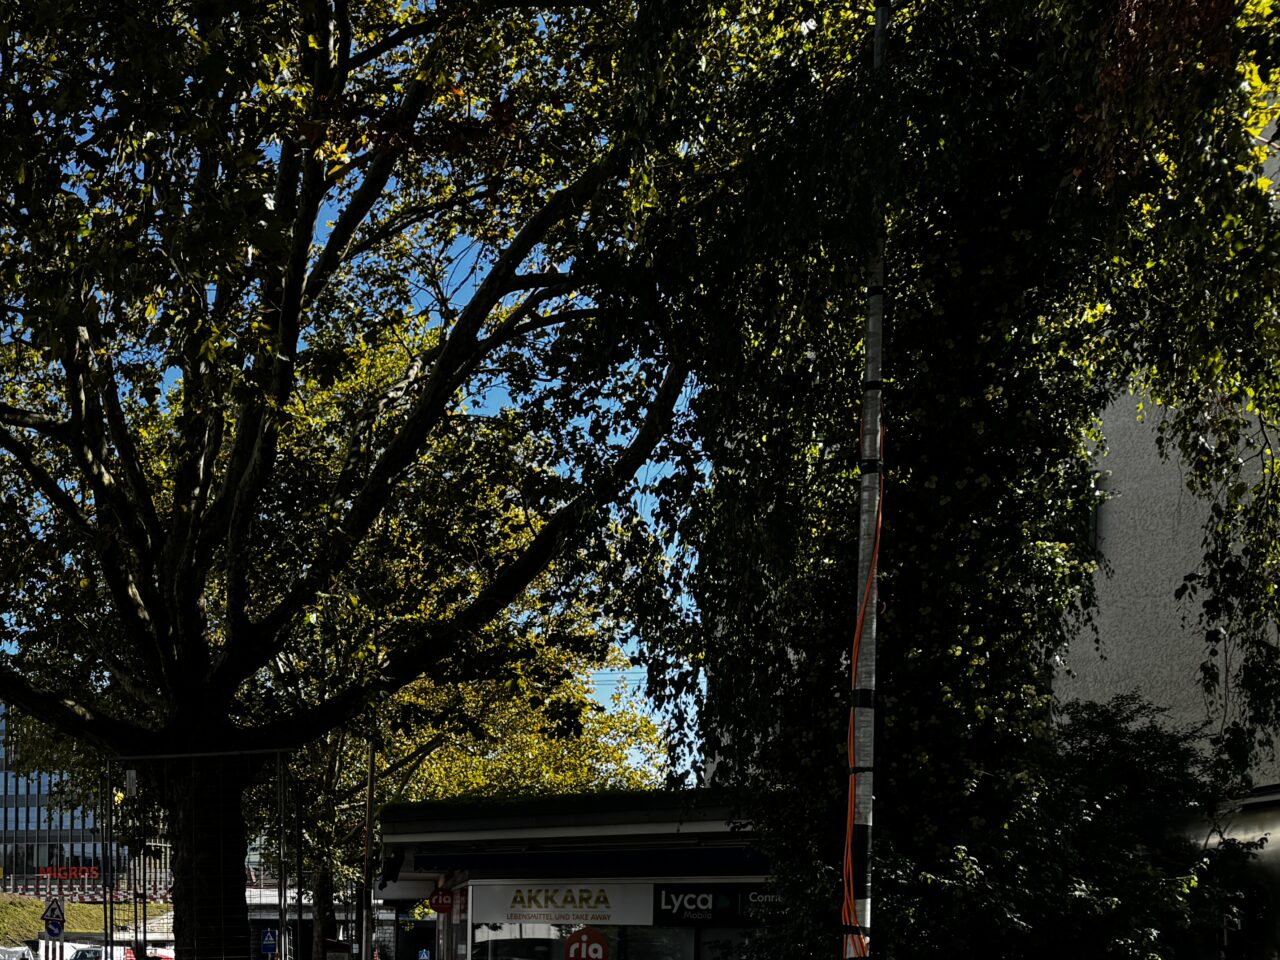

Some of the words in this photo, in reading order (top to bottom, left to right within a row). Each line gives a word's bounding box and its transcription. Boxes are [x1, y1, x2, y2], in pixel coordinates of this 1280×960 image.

[38, 866, 100, 880] MIGROS
[431, 891, 452, 905] ria
[510, 888, 612, 909] AKKARA
[660, 889, 713, 913] Lyca
[506, 912, 554, 921] LEBENSMITTEL
[555, 913, 570, 921] UND
[572, 913, 589, 921] TAKE
[590, 913, 612, 922] AWAY
[683, 911, 713, 920] Mobile
[569, 934, 604, 960] ria
